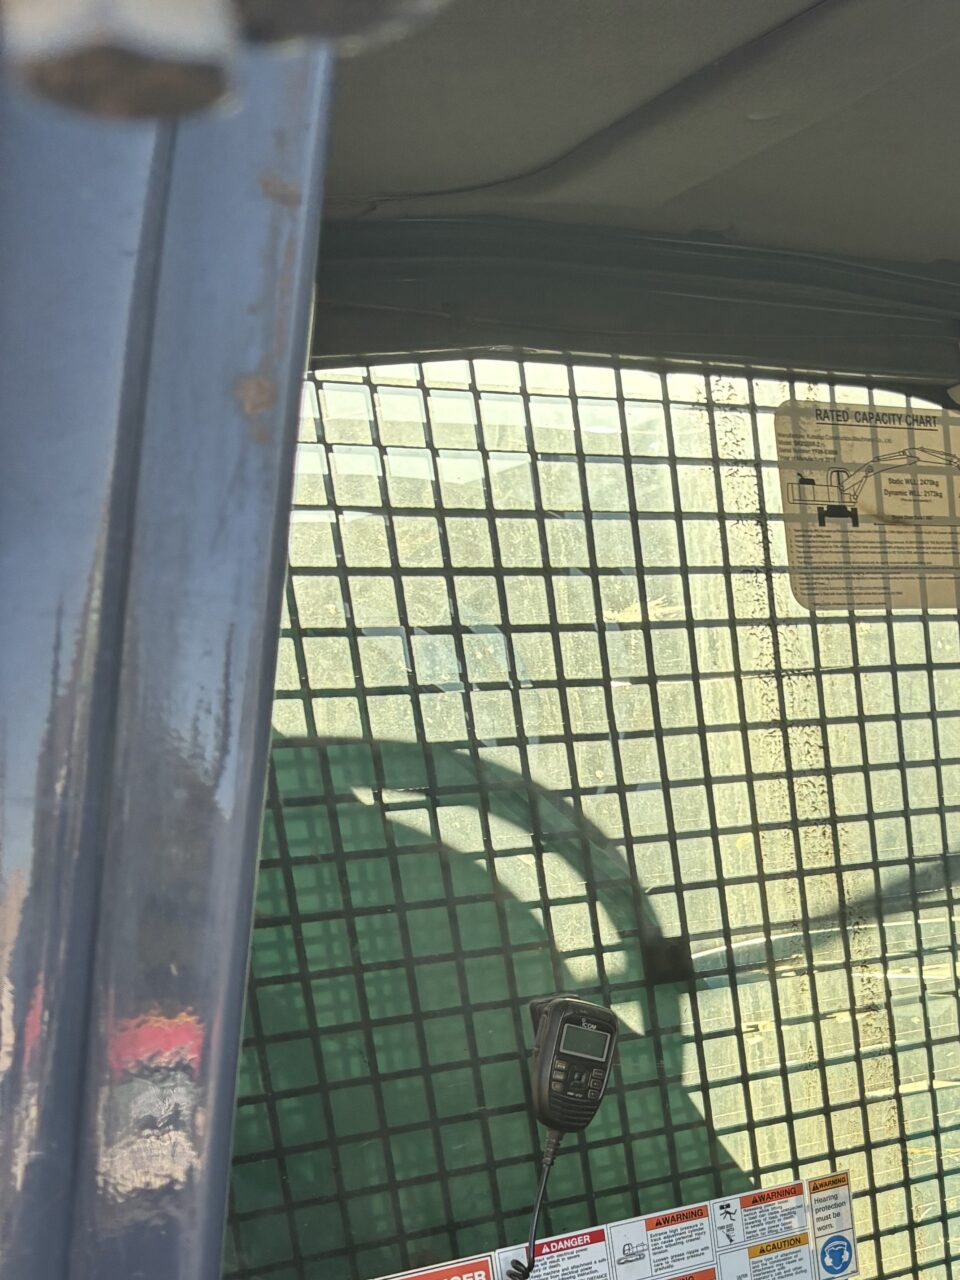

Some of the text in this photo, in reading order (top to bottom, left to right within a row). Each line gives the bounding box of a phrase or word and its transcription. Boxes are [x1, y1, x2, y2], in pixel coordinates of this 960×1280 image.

[816, 409, 938, 428] RATED CAPACITY CHART
[819, 1177, 846, 1188] WARNING
[757, 1187, 797, 1203] WARNING
[814, 1193, 838, 1205] Hearing
[814, 1201, 847, 1214] protection
[662, 1209, 704, 1225] WARNING
[815, 1214, 831, 1223] must
[817, 1223, 834, 1232] worn.
[550, 1235, 591, 1252] DANGER
[765, 1238, 801, 1252] CAUTION
